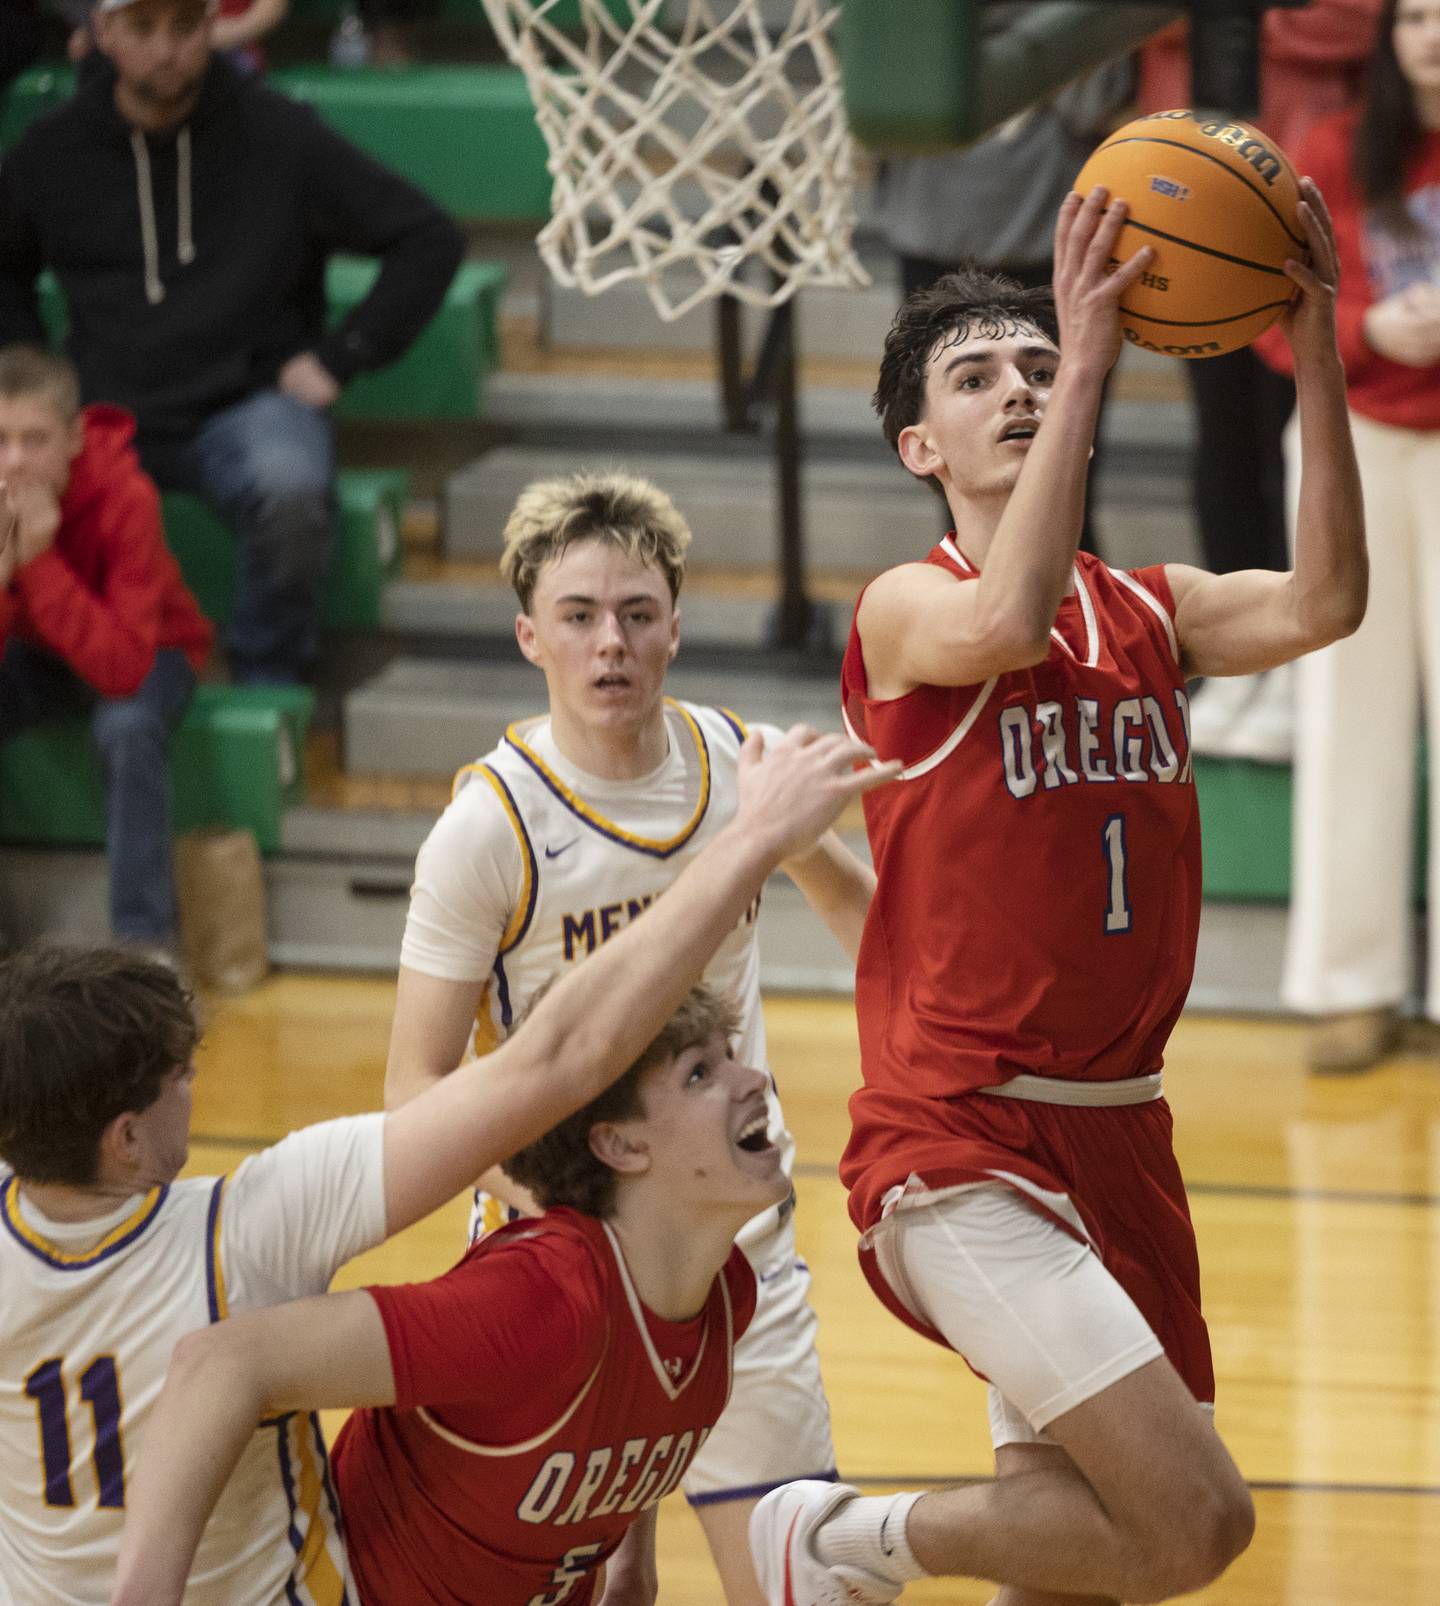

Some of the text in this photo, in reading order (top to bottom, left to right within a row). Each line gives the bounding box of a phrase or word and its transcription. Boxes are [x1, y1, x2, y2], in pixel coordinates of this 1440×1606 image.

[1139, 270, 1169, 293] HS
[1104, 812, 1134, 937] 1
[22, 1352, 128, 1512] 11
[526, 1535, 607, 1606] 5
